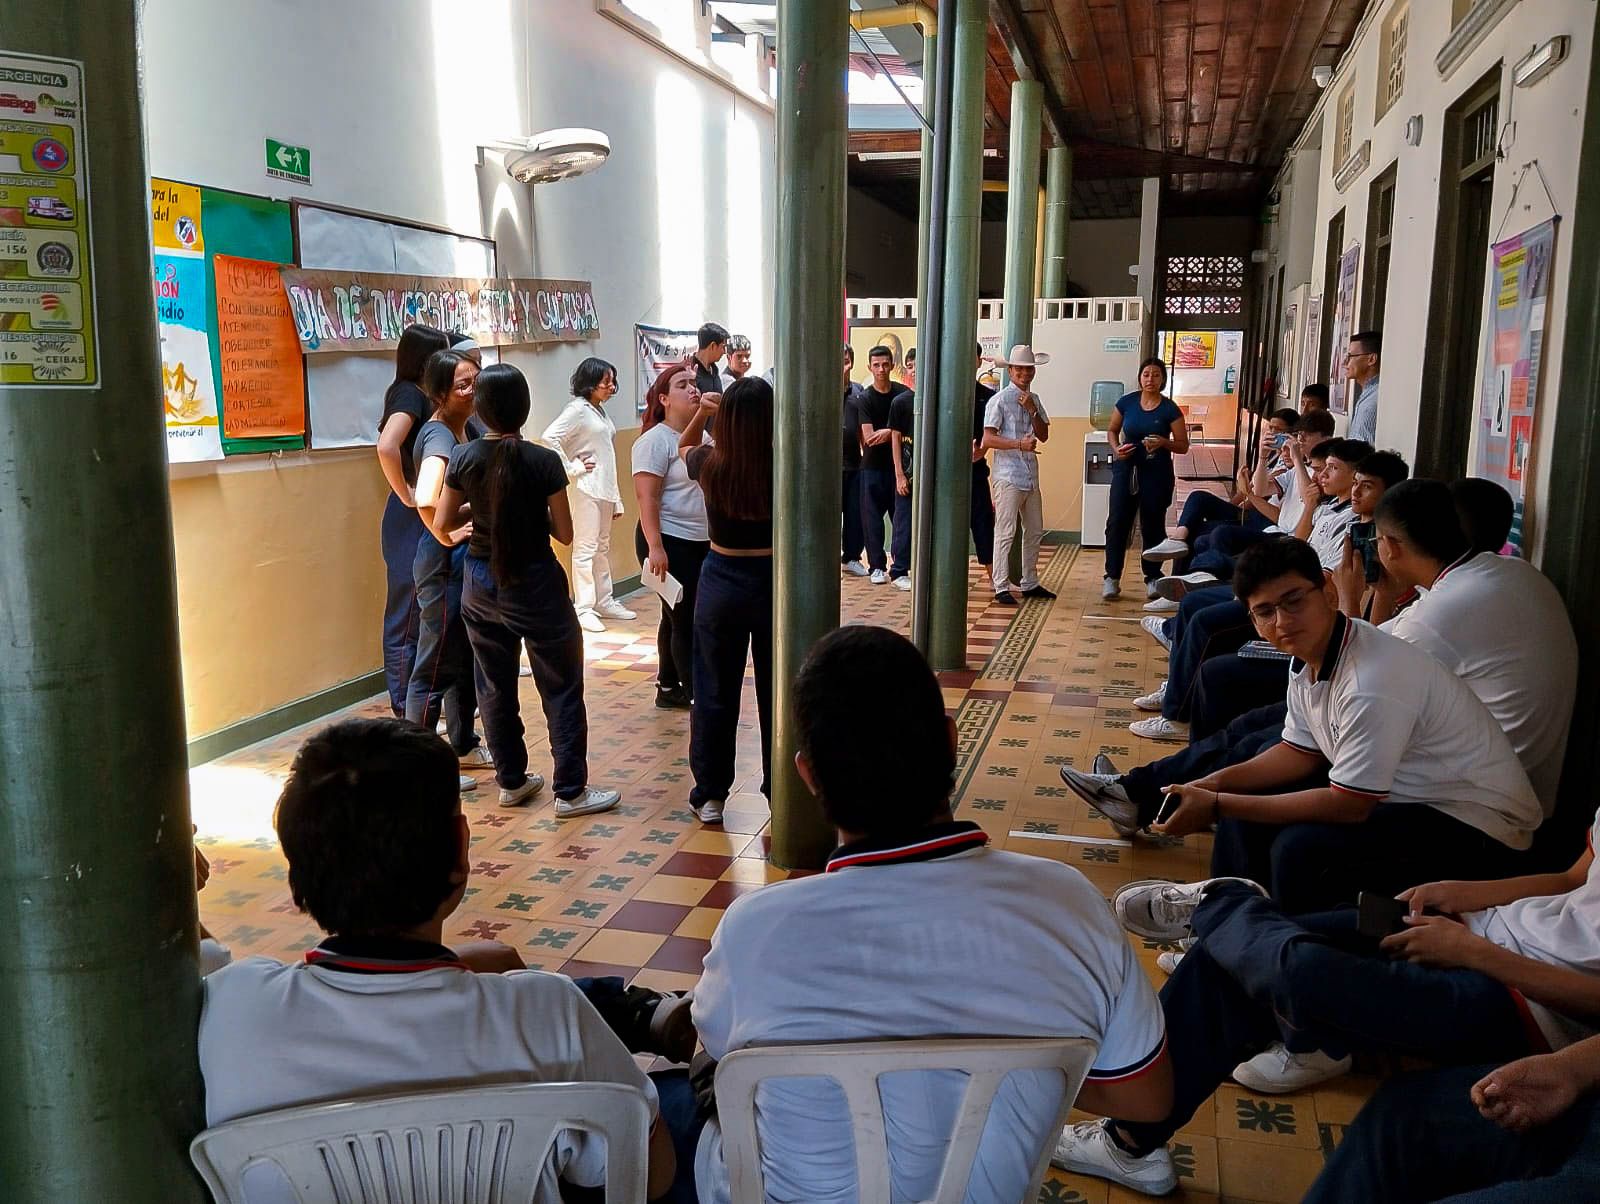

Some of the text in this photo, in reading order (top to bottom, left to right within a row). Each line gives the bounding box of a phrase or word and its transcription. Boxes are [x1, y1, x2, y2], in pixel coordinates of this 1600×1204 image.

[168, 187, 178, 204] la
[153, 205, 169, 222] del
[290, 285, 338, 341] DIA
[333, 285, 368, 340] DE
[536, 289, 600, 335] CULTURA
[46, 355, 85, 364] CEIBAS
